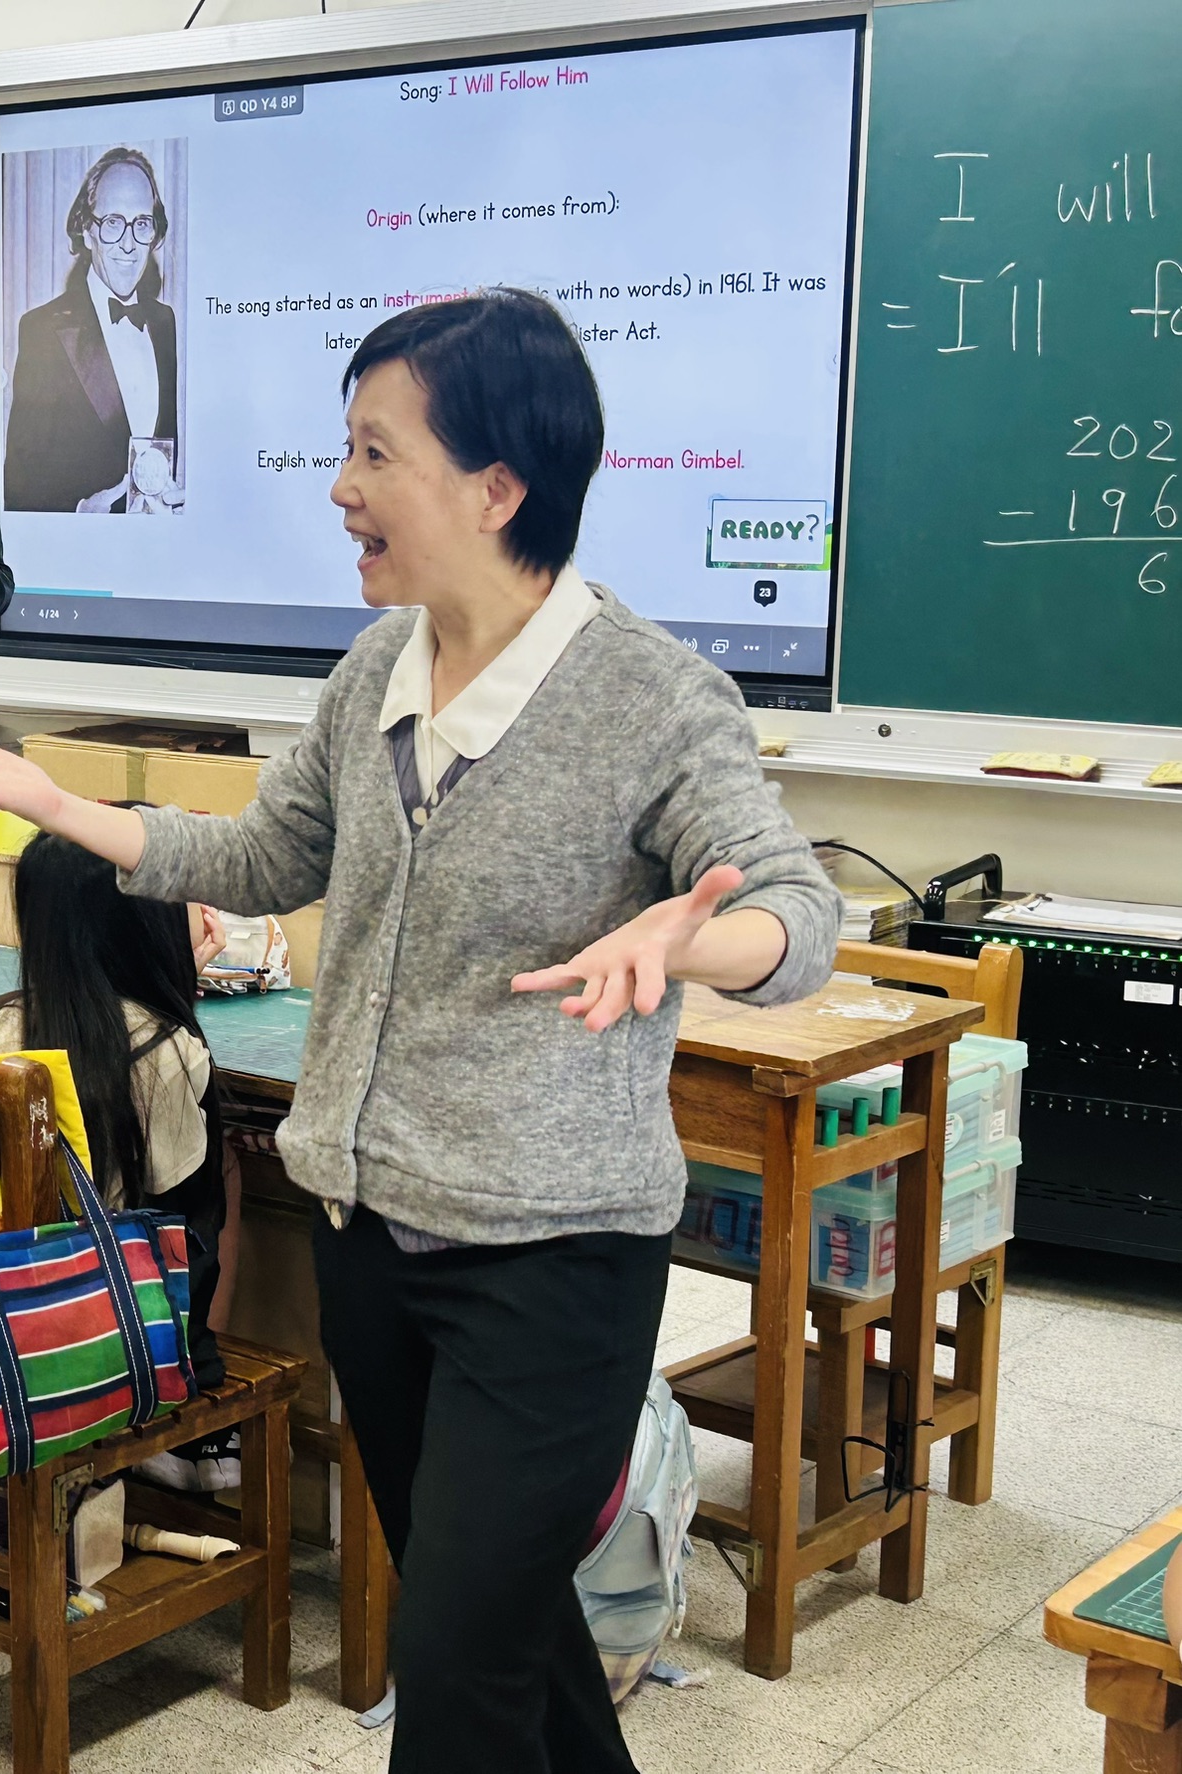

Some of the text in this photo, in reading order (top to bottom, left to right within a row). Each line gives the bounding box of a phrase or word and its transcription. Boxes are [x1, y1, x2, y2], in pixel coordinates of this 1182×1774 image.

[400, 65, 589, 103] Song: I Will Follow Him
[239, 95, 297, 114] QD Y4 8P
[933, 152, 1156, 223] I will
[366, 190, 620, 231] Origin (where it comes from):
[205, 296, 232, 315] The
[237, 302, 270, 317] song
[275, 291, 331, 312] started
[337, 296, 354, 310] as
[360, 295, 378, 309] an
[383, 285, 485, 308] instrument
[556, 280, 593, 300] with
[600, 285, 620, 299] no
[627, 273, 692, 298] words)
[699, 279, 713, 295] in
[720, 272, 756, 294] 1961.
[762, 271, 780, 292] It
[788, 276, 826, 291] was
[571, 320, 661, 342] ister Act.
[1065, 415, 1177, 462] 202
[258, 450, 306, 472] English
[604, 448, 745, 469] Norman Gimbel.
[720, 513, 820, 542] READY?
[1138, 551, 1168, 594] 6
[758, 587, 771, 598] 23
[38, 608, 60, 619] 4/24
